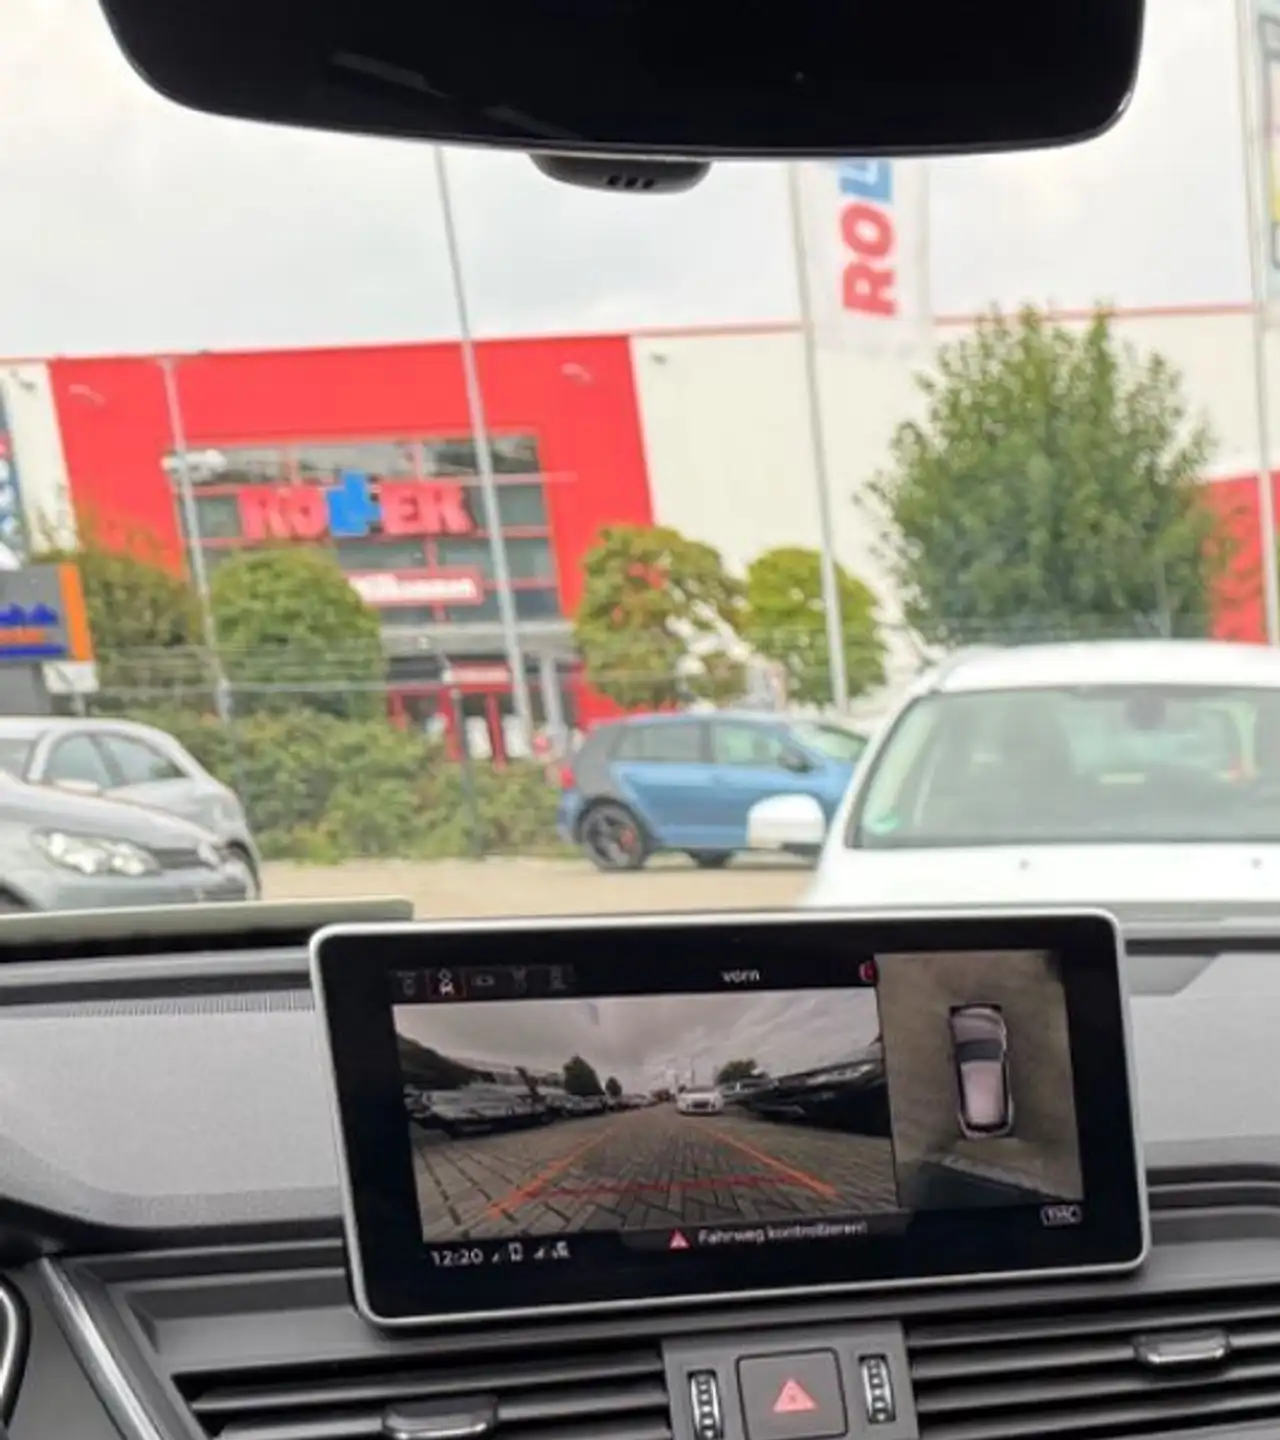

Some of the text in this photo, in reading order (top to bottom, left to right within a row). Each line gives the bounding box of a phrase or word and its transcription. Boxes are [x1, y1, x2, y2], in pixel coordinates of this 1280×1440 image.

[839, 158, 897, 318] ROL
[698, 1228, 766, 1245] Fahrweg
[430, 1248, 484, 1267] 12:20
